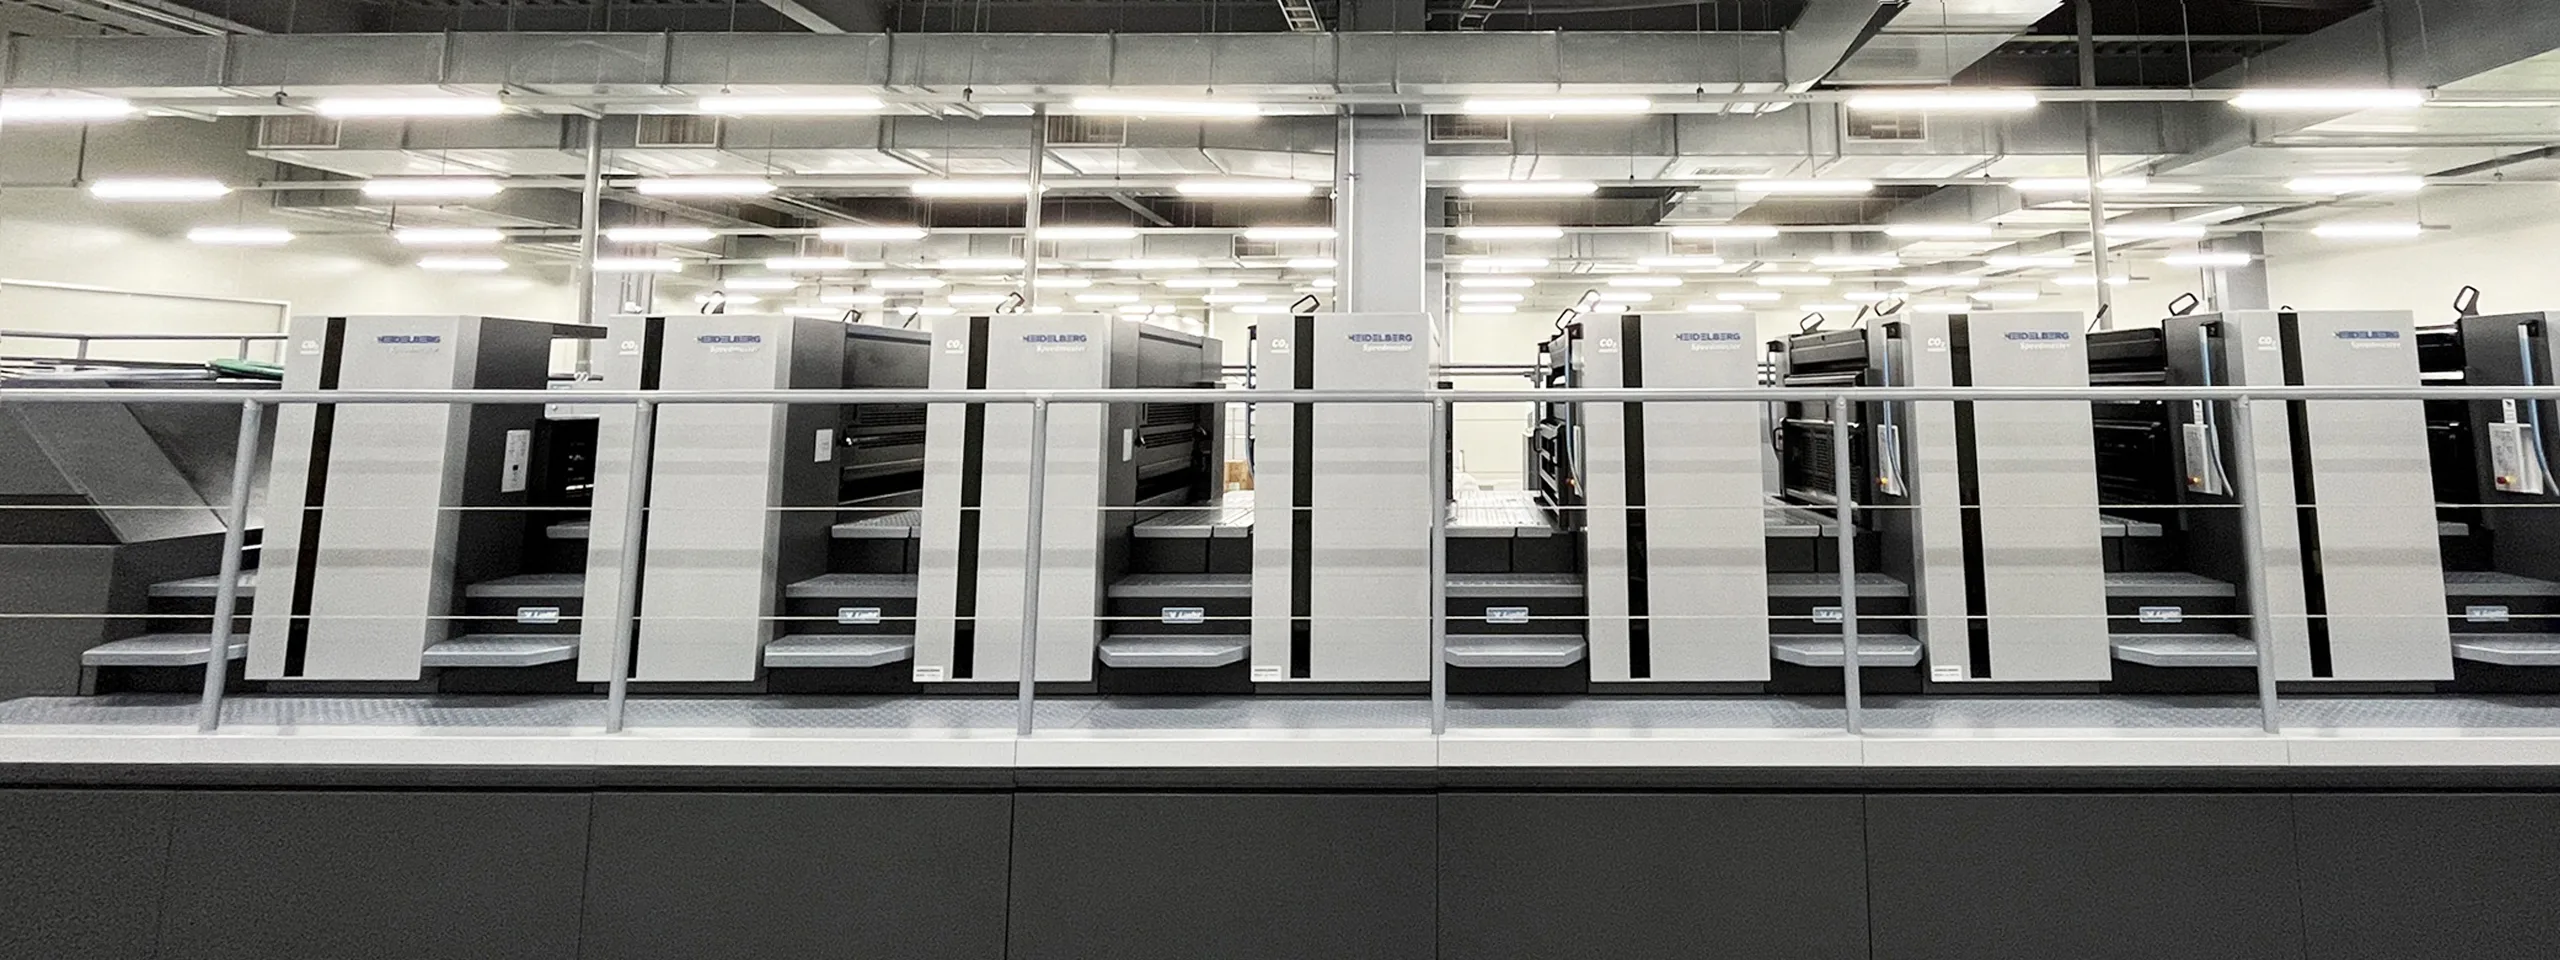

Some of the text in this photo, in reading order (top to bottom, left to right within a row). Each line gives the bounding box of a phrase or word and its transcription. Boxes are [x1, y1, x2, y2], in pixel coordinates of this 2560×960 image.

[1023, 334, 1087, 343] HEIDELBERG
[1348, 334, 1412, 342] HEIDELBERG
[1676, 333, 1740, 341] HEIDELBERG
[2005, 332, 2069, 340] HEIDELBERG
